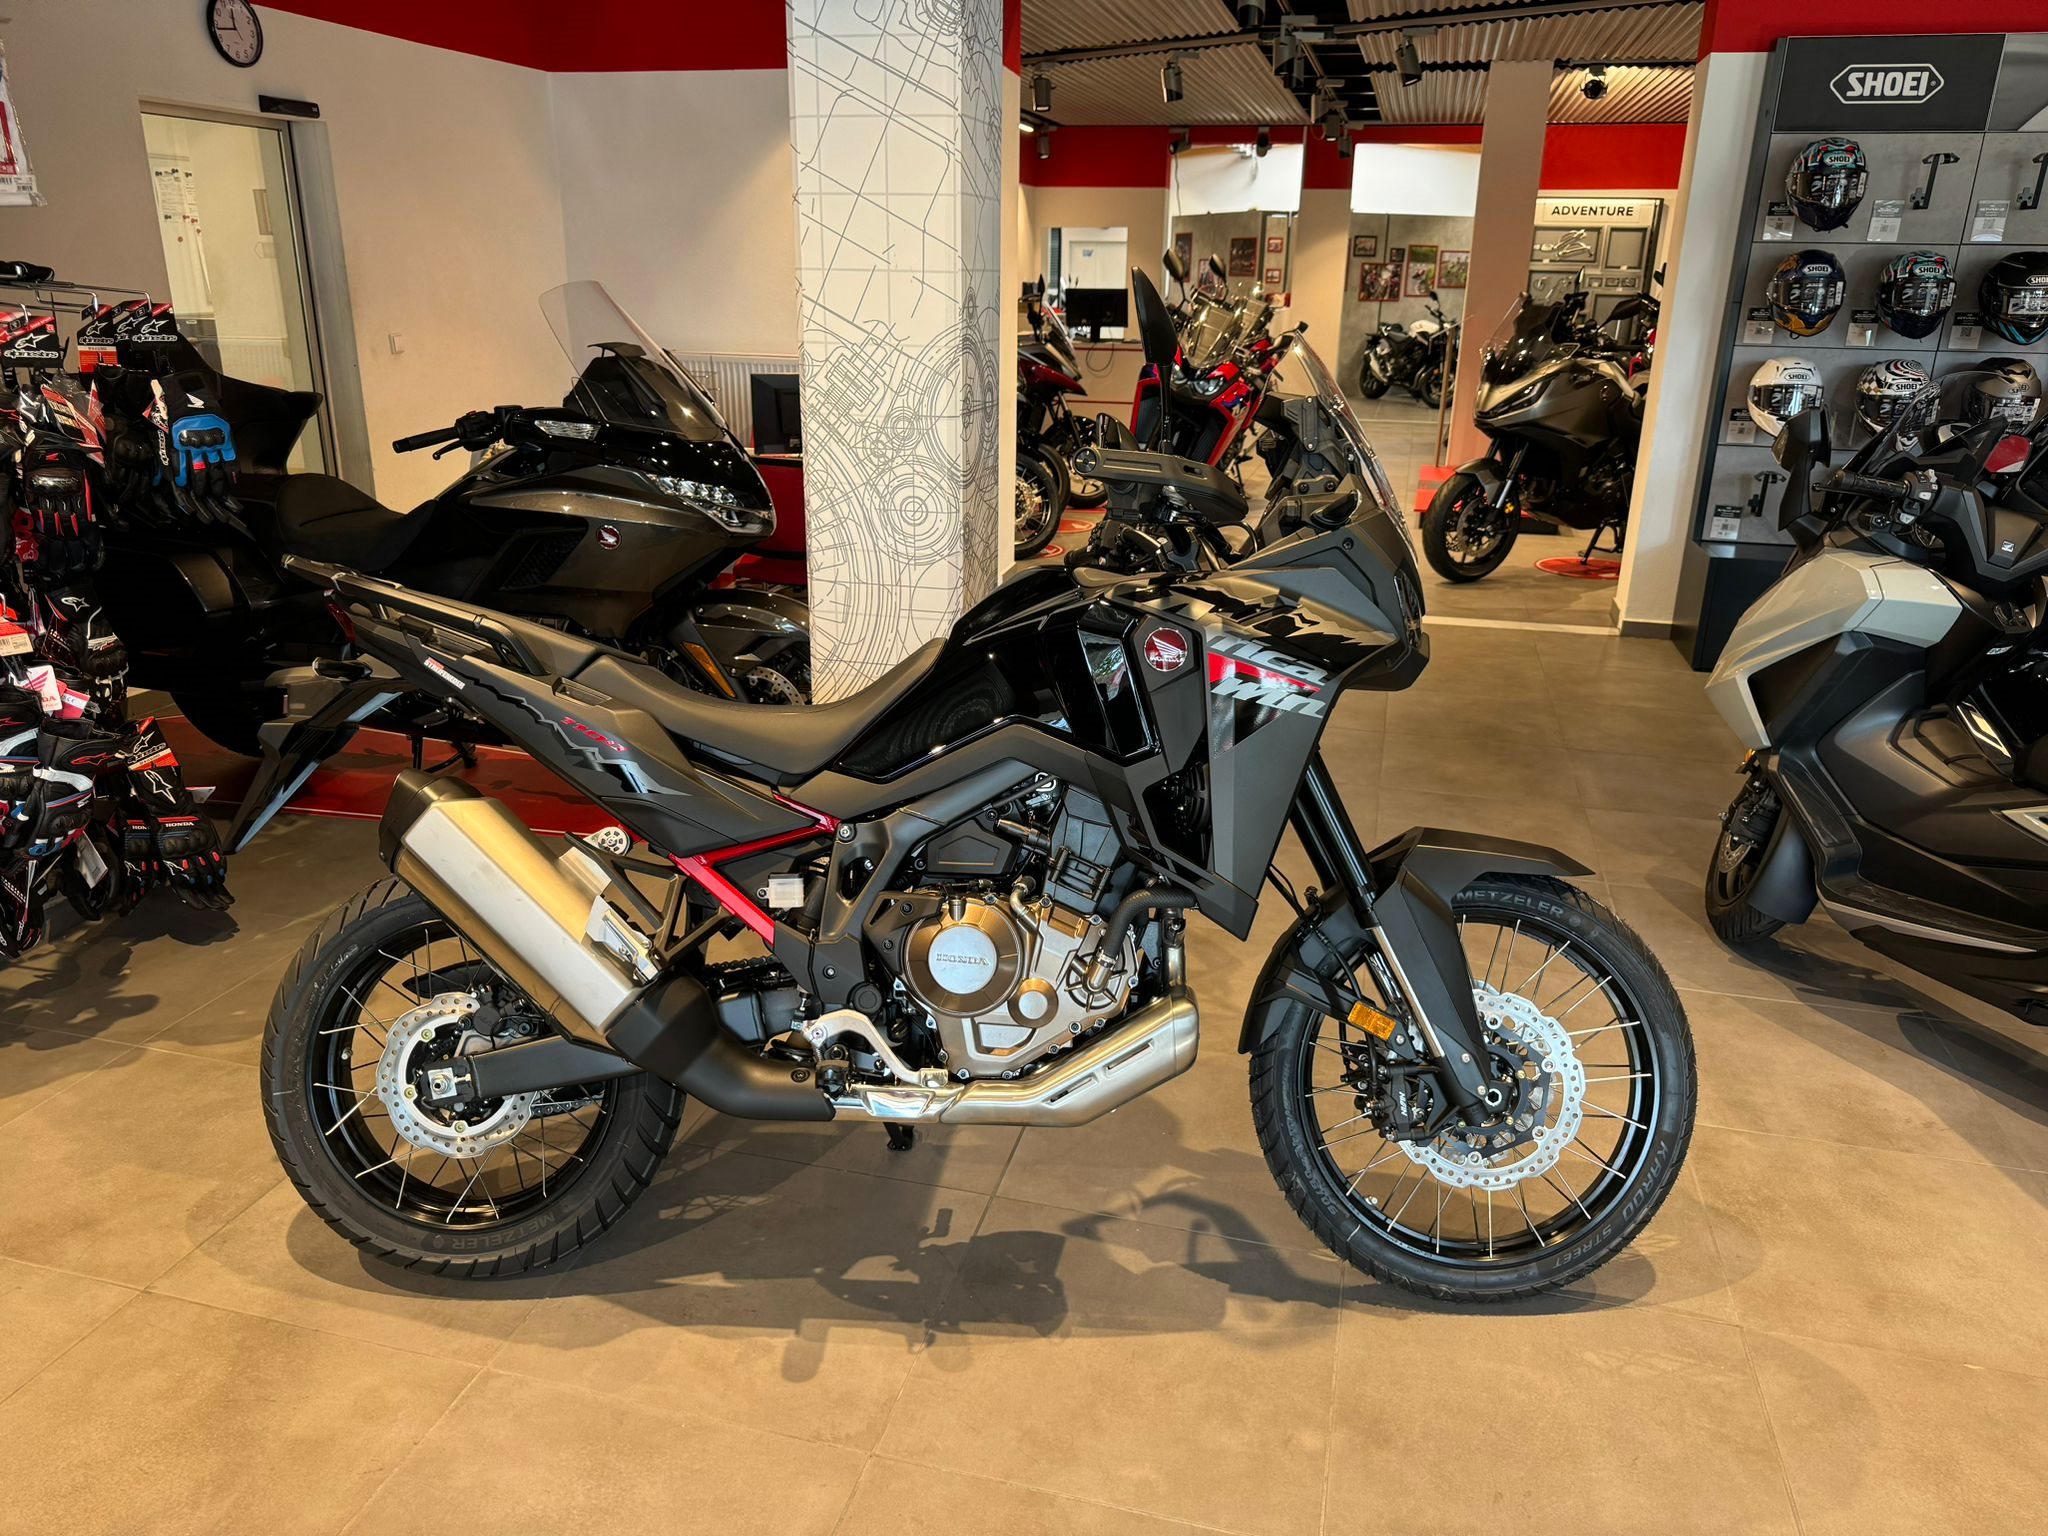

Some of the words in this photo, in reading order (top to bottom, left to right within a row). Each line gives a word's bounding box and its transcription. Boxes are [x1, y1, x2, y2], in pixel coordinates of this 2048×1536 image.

[1846, 71, 1930, 97] SHOEI
[1828, 155, 1850, 164] SHOEI
[1551, 205, 1635, 217] ADVENTURE
[1807, 265, 1829, 273] SHOEI
[1918, 266, 1940, 274] SHOEI
[1787, 373, 1808, 381] SHOEI
[1895, 382, 1919, 391] SHOEI
[165, 821, 194, 829] HONDA
[1456, 890, 1565, 919] METZELER
[936, 952, 990, 967] HONDA
[1621, 1140, 1670, 1222] KAROO
[450, 1212, 555, 1250] METZELER
[1552, 1224, 1613, 1269] STREET
